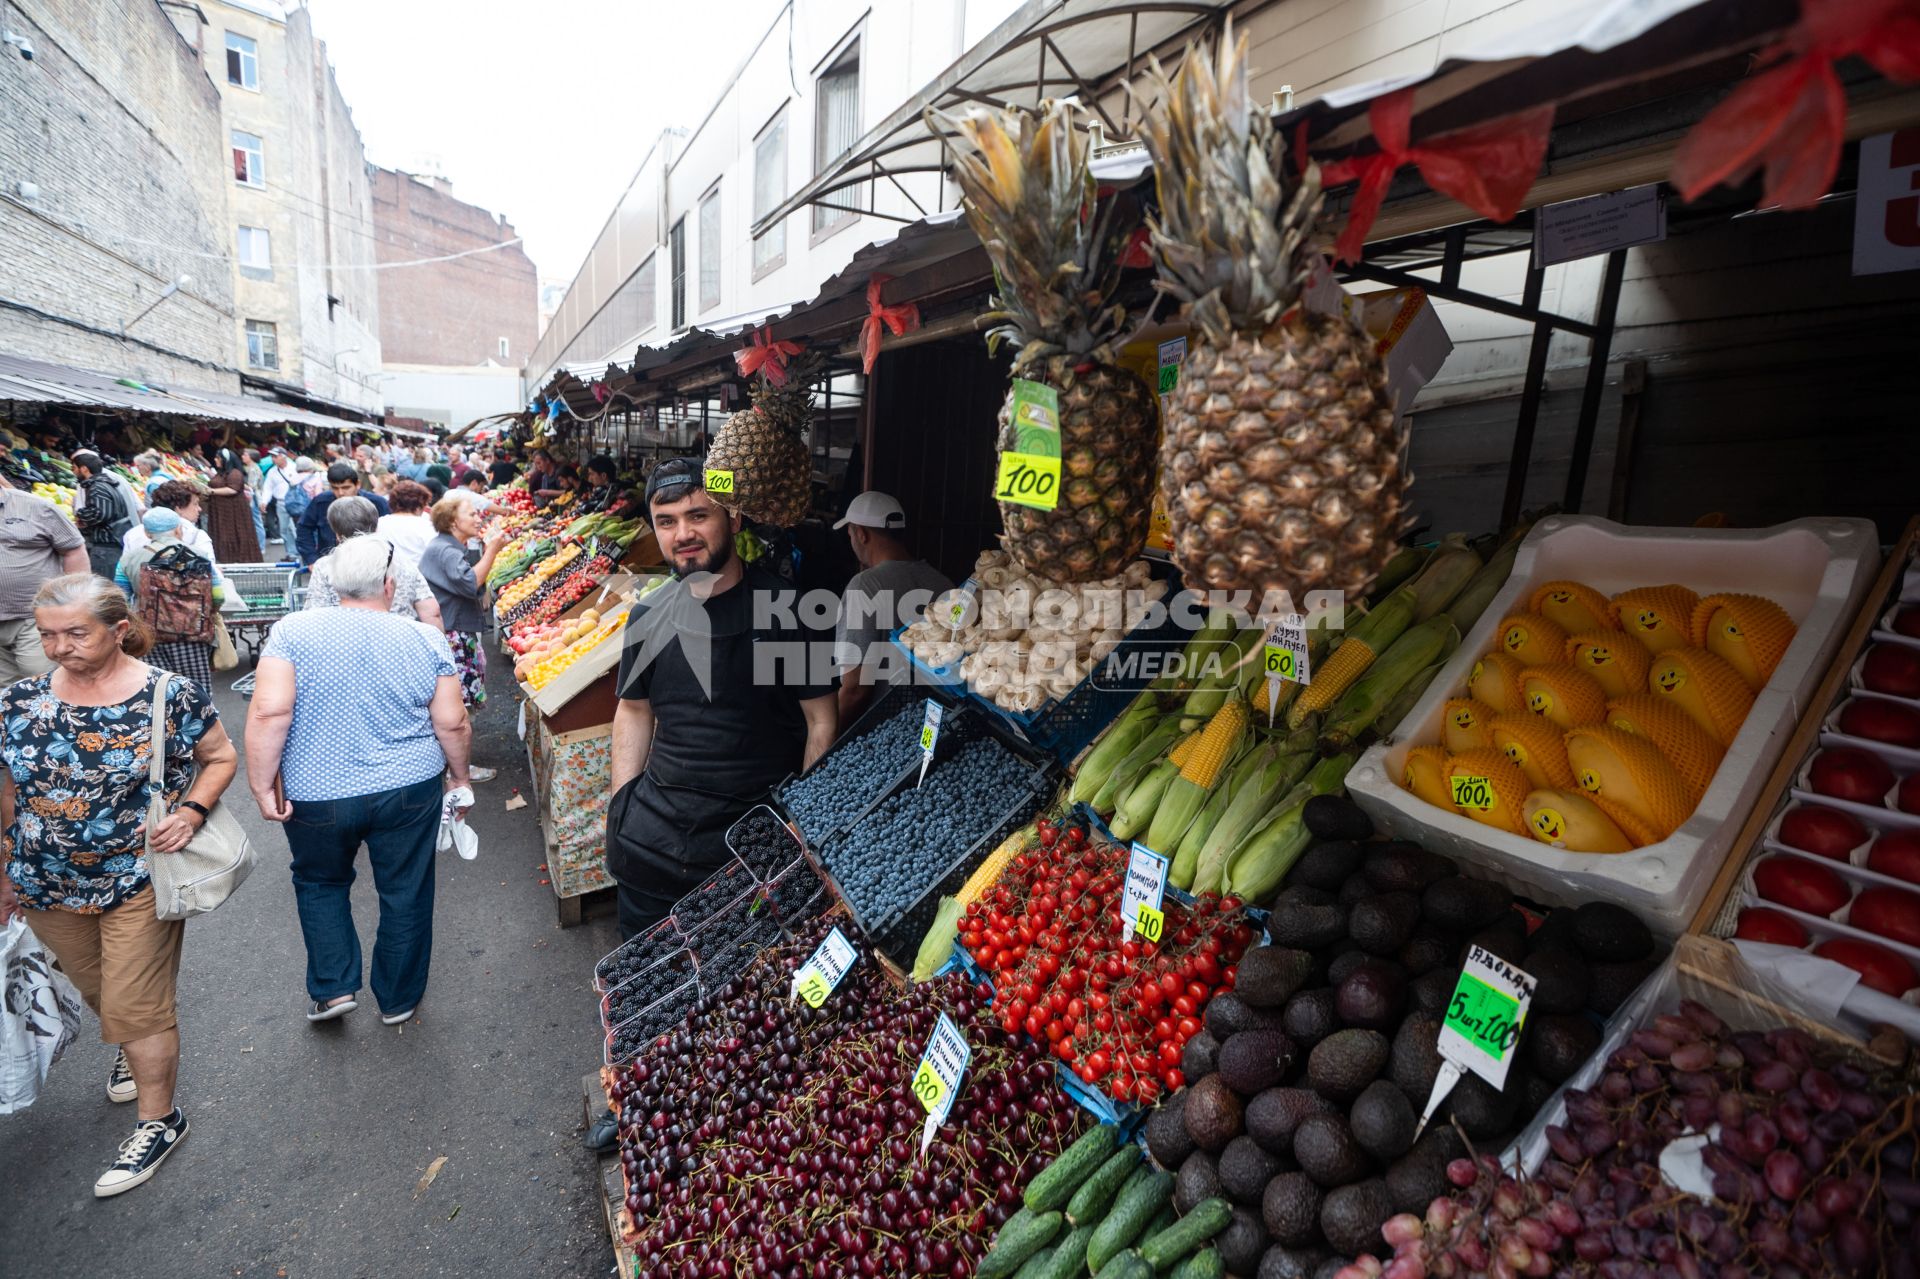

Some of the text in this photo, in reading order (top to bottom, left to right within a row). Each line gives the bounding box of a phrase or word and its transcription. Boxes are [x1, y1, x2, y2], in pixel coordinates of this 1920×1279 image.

[706, 474, 732, 490] 100
[999, 464, 1054, 497] 100
[1267, 653, 1291, 673] 60
[1139, 911, 1159, 938] 40
[801, 979, 824, 1002] 70
[914, 1072, 939, 1101] 80
